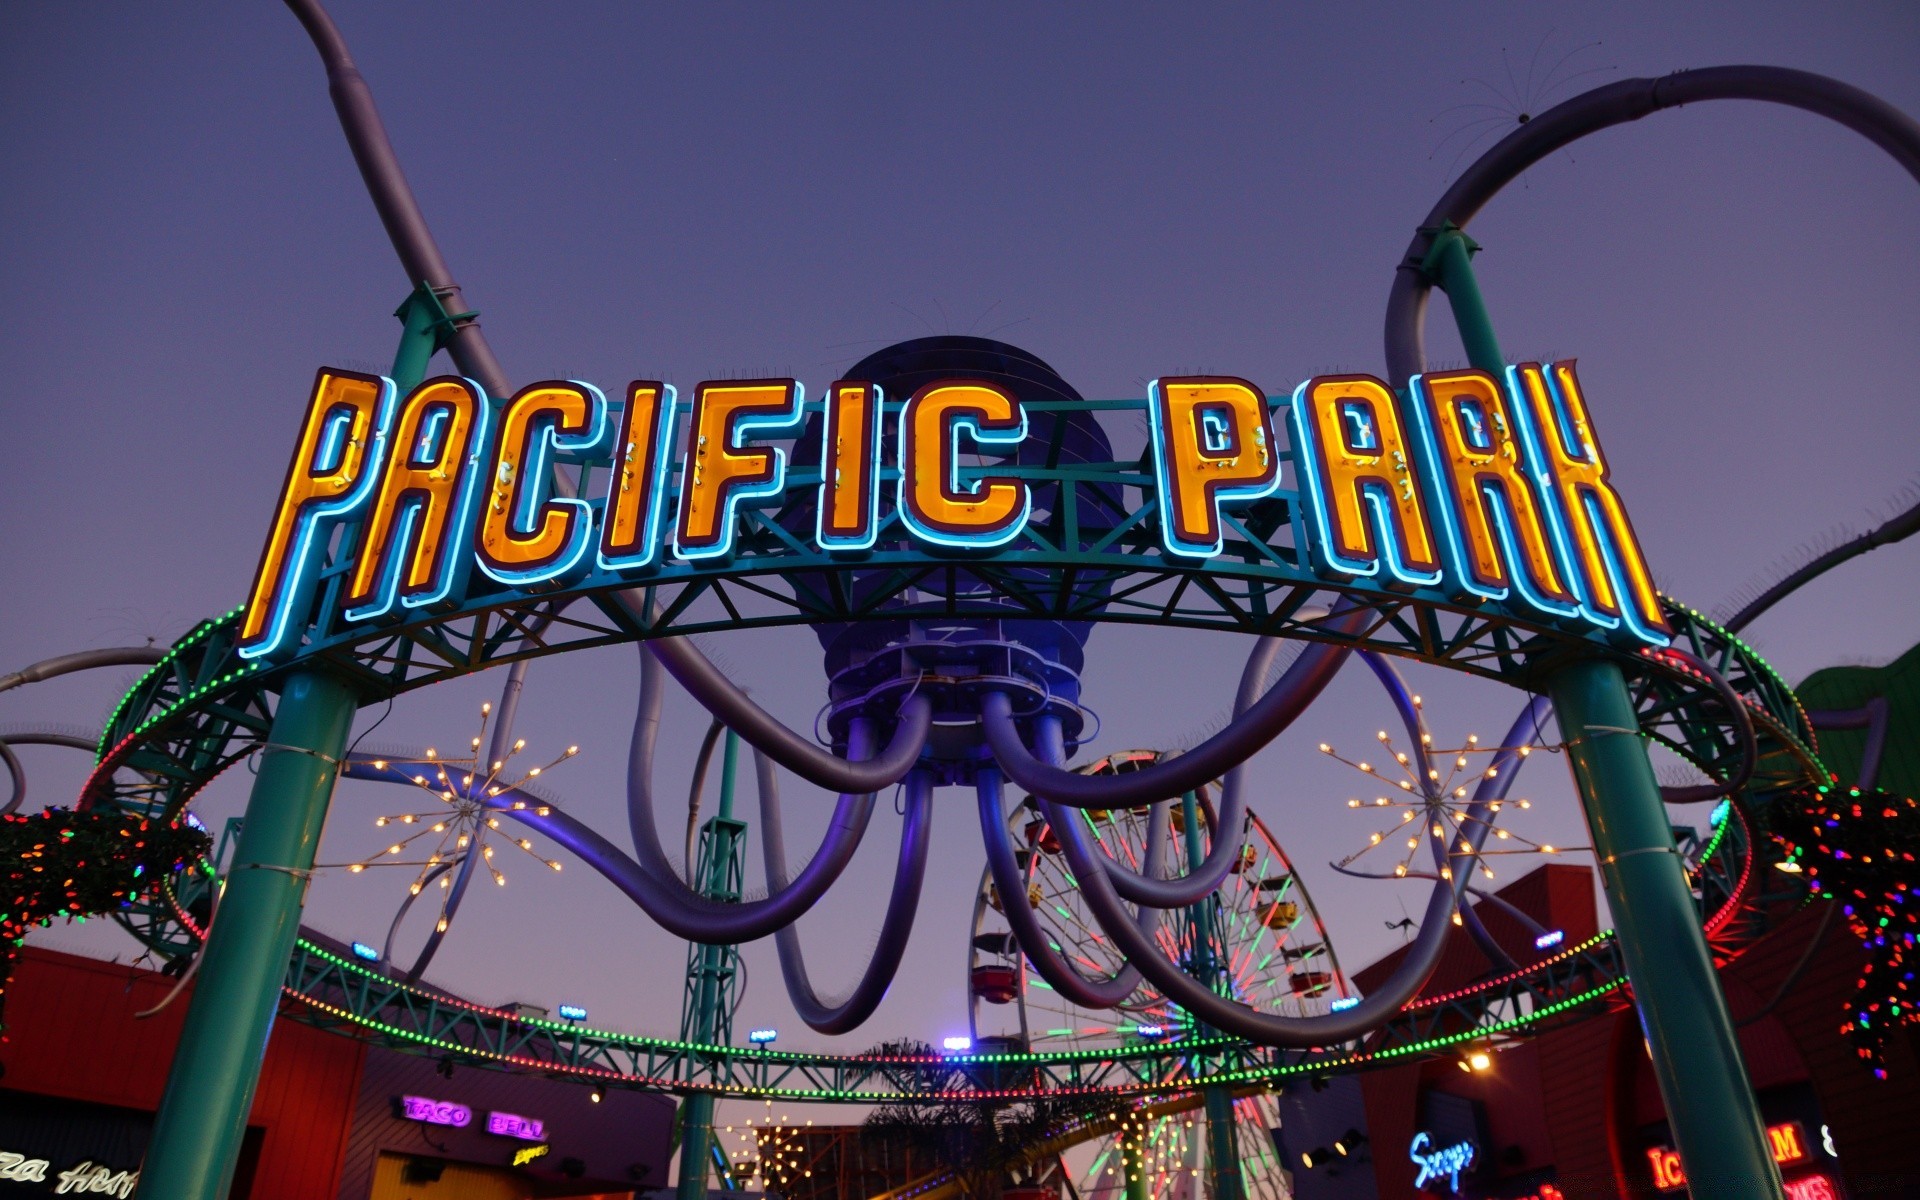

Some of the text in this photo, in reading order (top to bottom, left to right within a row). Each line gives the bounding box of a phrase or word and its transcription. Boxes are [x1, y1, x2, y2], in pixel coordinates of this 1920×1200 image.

[237, 358, 1674, 658] PACIFIC PARK
[402, 1095, 549, 1141] TACO BELL
